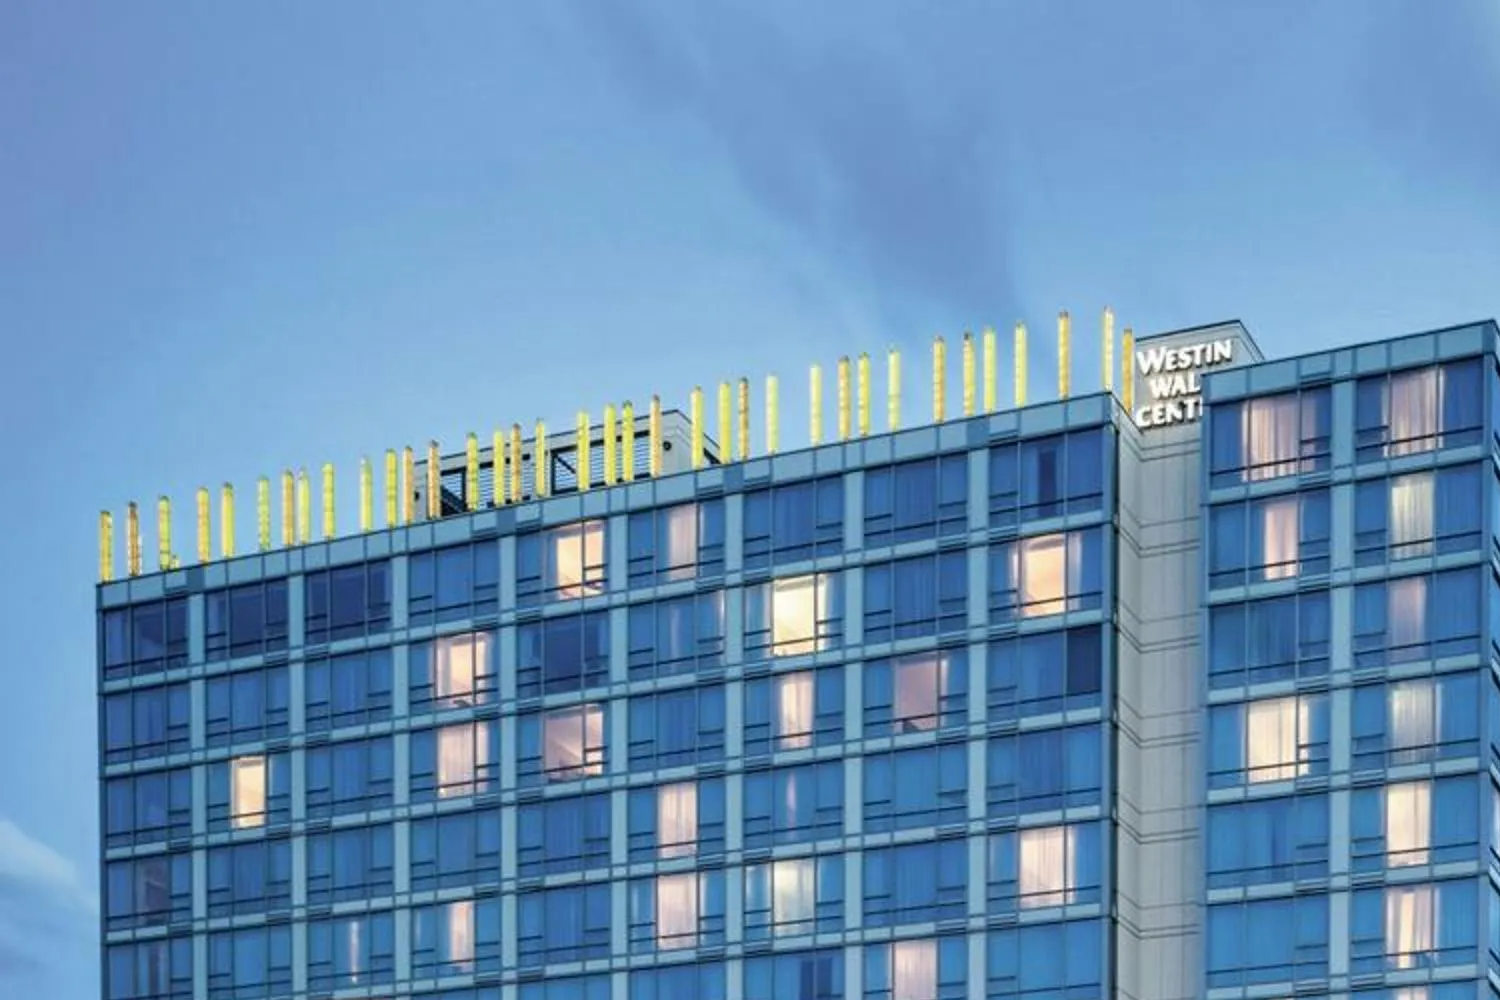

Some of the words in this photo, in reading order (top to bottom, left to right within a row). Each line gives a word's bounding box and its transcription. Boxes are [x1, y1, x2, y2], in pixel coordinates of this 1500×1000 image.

[1136, 338, 1232, 376] WESTIN
[1149, 371, 1202, 400] WAL
[1135, 396, 1203, 428] CENT
